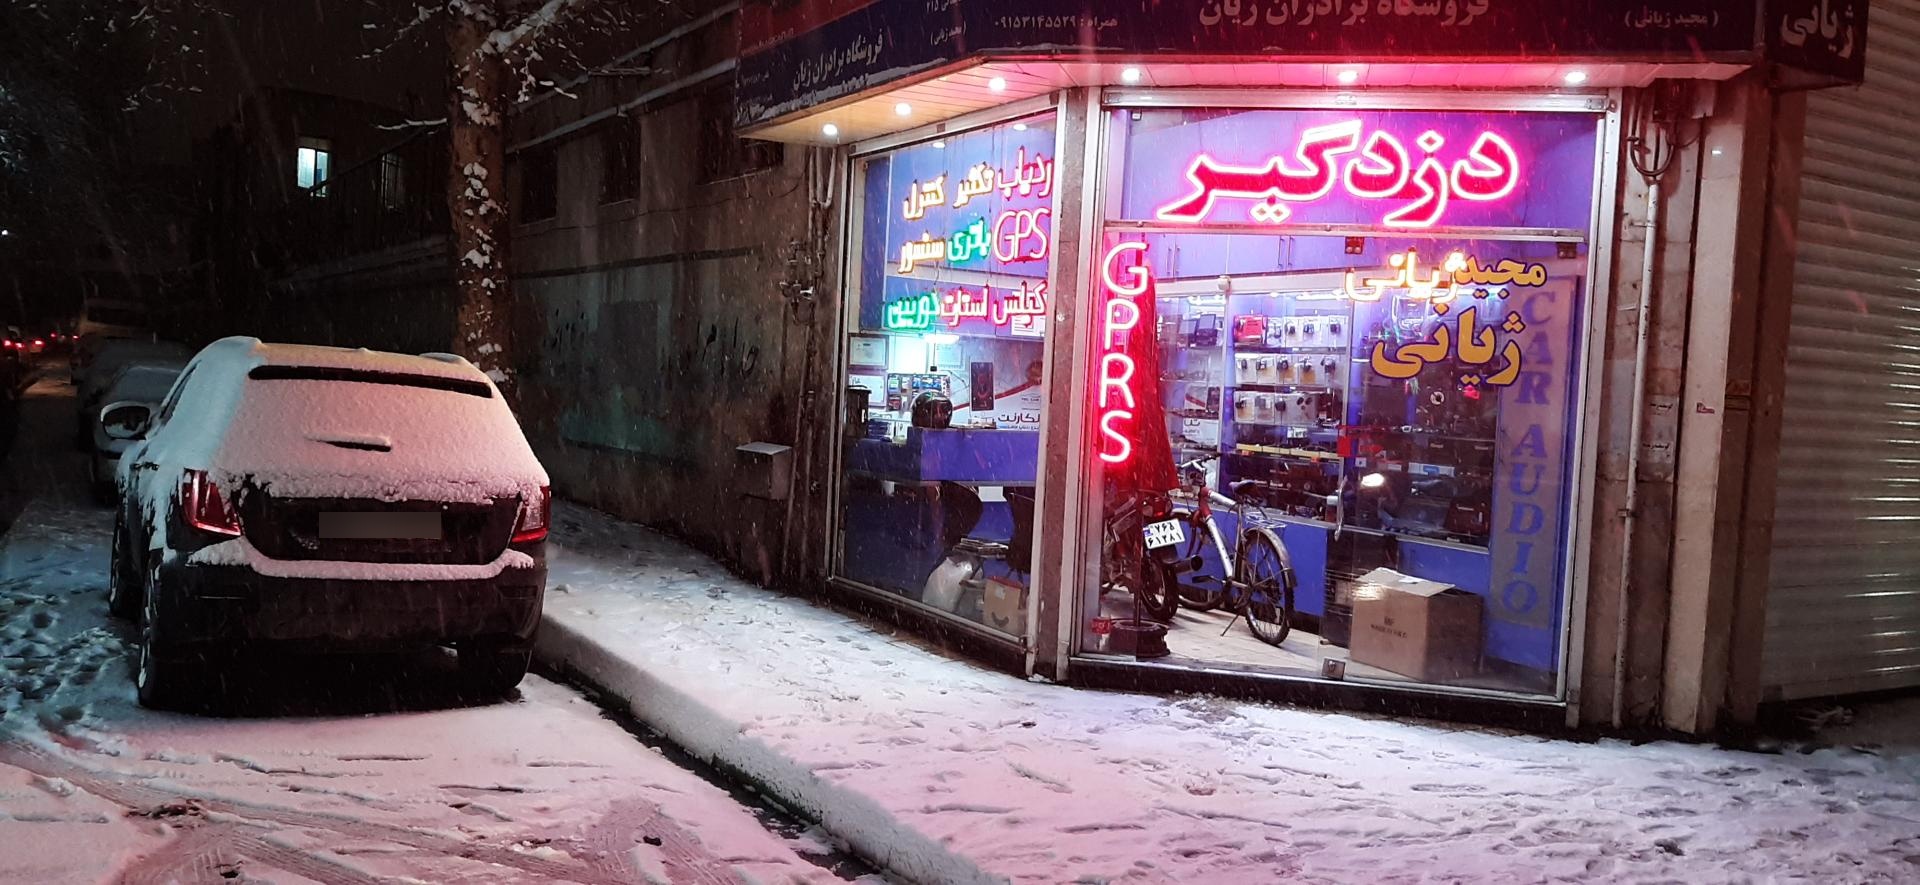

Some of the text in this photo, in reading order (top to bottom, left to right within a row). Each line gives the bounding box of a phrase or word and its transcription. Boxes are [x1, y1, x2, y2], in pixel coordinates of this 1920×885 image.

[811, 47, 846, 84] برادران
[846, 28, 884, 66] فروشگاه
[903, 173, 949, 220] کنترل
[996, 147, 1054, 201] ردیاب
[1156, 119, 1520, 227] دزدگیر
[897, 217, 991, 274] باتری سنسور
[993, 208, 1051, 264] GPS
[1454, 255, 1548, 300] مجید
[1098, 240, 1149, 464] GPRS
[1371, 303, 1526, 387] ژیانی
[1501, 290, 1557, 615] CAR AUDIO
[1147, 532, 1182, 548] ۶۱۲۸۱
[1154, 521, 1176, 533] ۷۶۵
